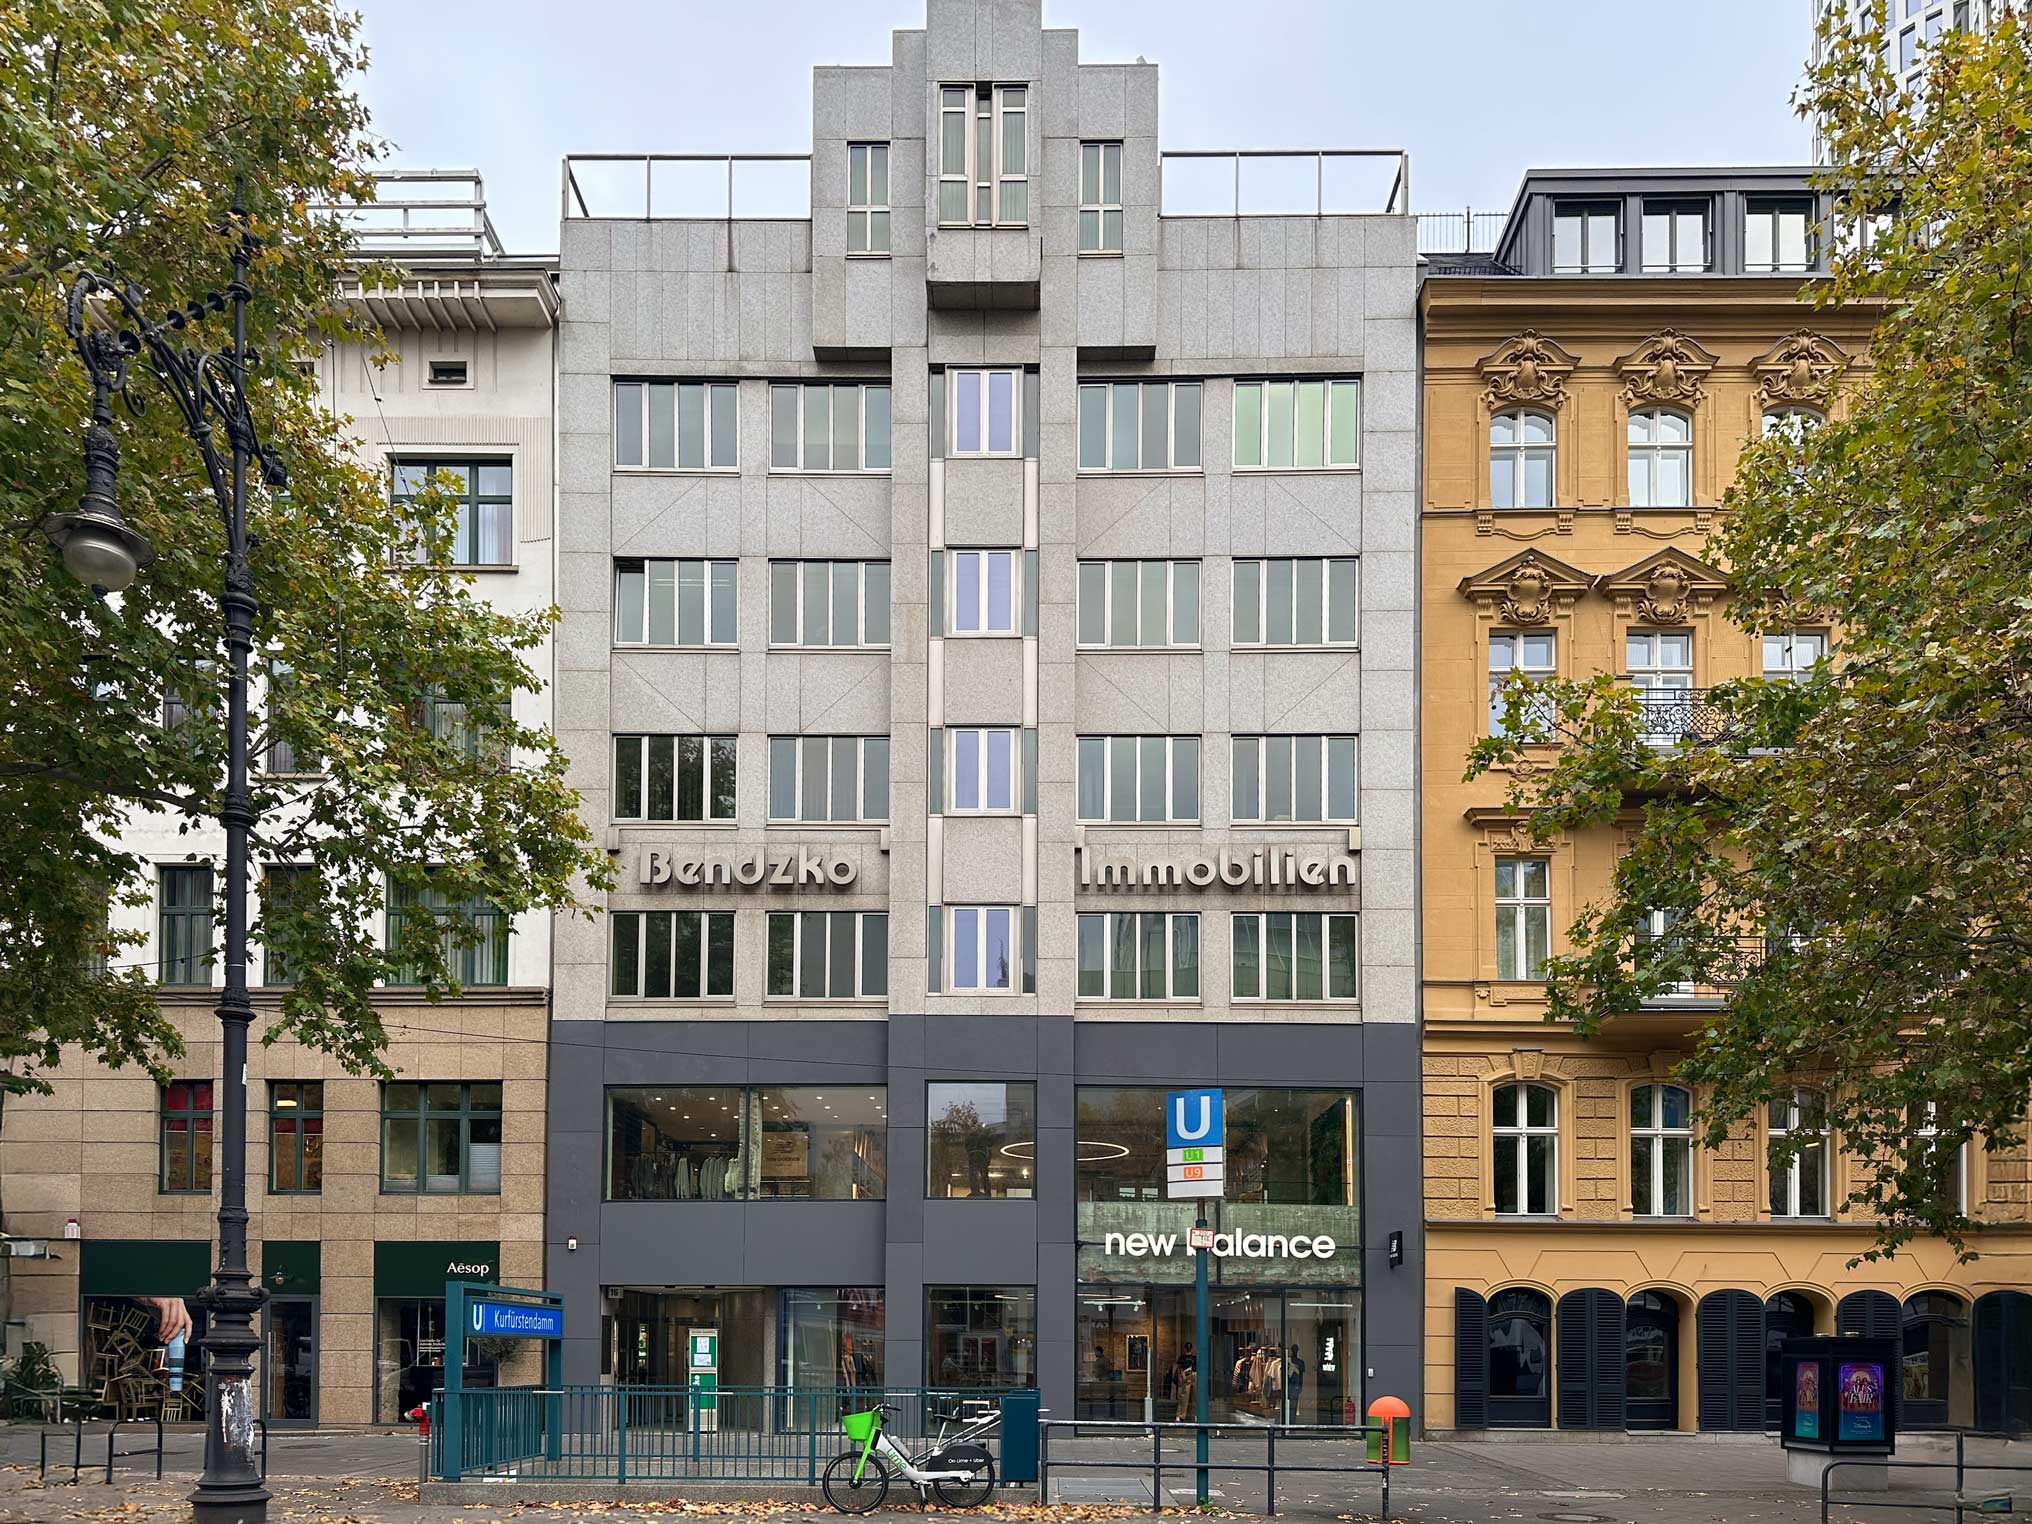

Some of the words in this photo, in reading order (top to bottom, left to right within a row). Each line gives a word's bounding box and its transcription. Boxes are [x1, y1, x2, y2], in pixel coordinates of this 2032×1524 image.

[640, 846, 858, 886] Bendzko
[1081, 846, 1357, 887] Immobilien
[1176, 1095, 1210, 1140] U
[1185, 1151, 1201, 1160] U1
[1185, 1167, 1202, 1178] U9
[1104, 1232, 1178, 1257] new
[473, 1304, 483, 1331] U
[494, 1309, 554, 1331] Kurfürstendamm
